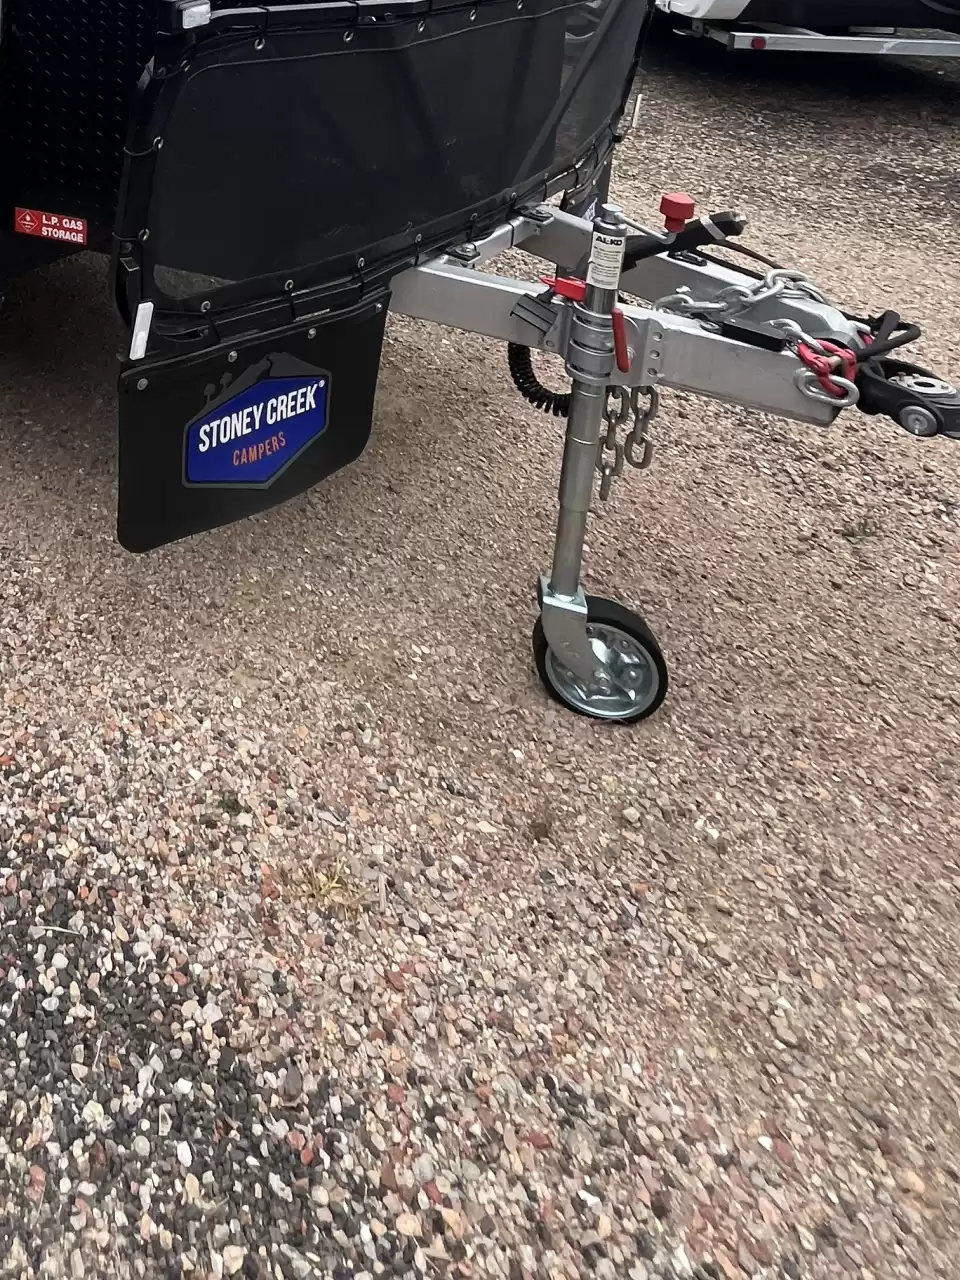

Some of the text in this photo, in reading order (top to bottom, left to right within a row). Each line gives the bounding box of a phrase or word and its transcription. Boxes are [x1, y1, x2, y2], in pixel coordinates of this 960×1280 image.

[41, 226, 84, 243] STORAGE
[42, 214, 83, 231] L.P. GAS
[198, 402, 264, 453] STONEY
[232, 431, 287, 466] CAMPERS
